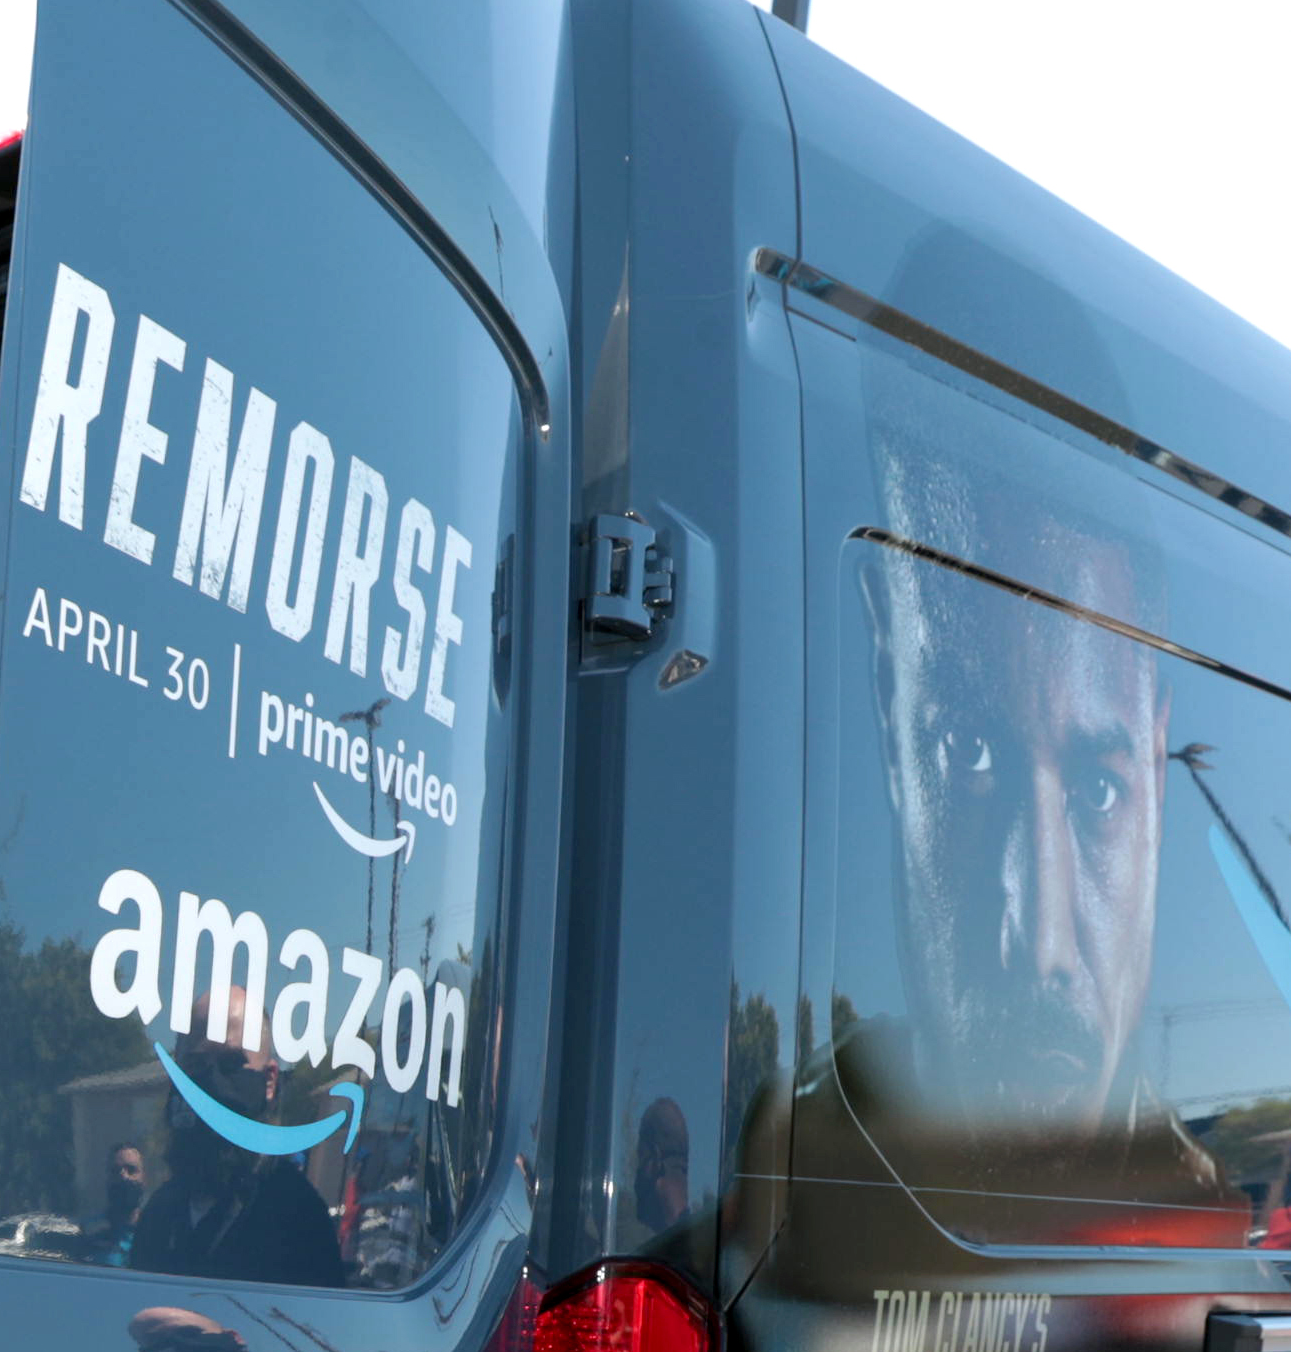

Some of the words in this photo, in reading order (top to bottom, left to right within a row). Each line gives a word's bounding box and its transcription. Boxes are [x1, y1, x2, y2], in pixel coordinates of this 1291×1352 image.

[20, 262, 473, 728] REMORSE
[23, 587, 149, 688] APRIL
[163, 645, 210, 711] 30
[258, 689, 369, 783] prime
[376, 738, 458, 827] video
[90, 868, 467, 1109] amazon
